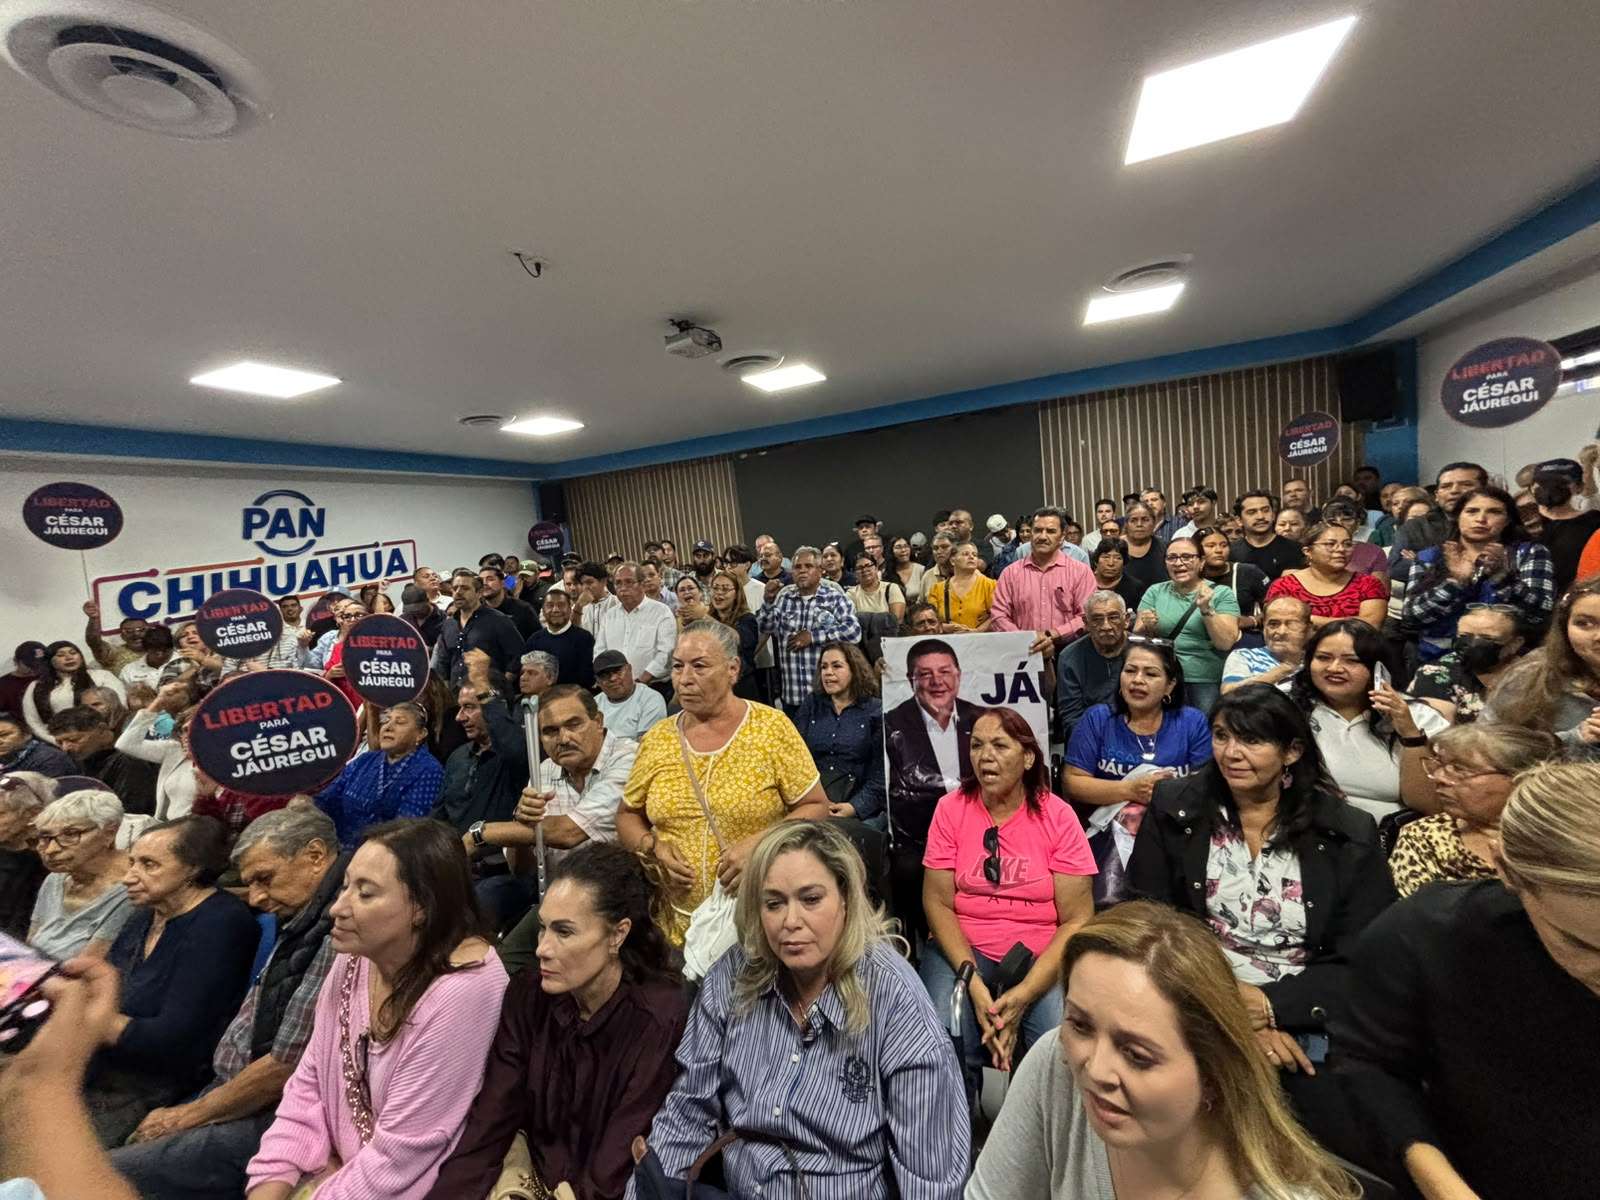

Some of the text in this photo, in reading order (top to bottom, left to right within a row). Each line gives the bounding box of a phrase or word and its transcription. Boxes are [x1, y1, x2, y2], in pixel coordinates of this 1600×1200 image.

[1451, 350, 1546, 380] LIBERTAD
[1485, 371, 1509, 380] PARA
[1462, 376, 1535, 401] CÉSAR
[1459, 390, 1540, 414] JÁUREGUI
[1289, 436, 1327, 450] CÉSAR
[45, 513, 104, 527] CÉSAR
[242, 507, 326, 541] PAN
[43, 525, 108, 536] JÁUREGUI
[215, 621, 267, 638] CÉSAR
[216, 631, 273, 648] JÁUREGUI
[349, 636, 417, 649] LIBERTAD
[360, 658, 411, 675] CÉSAR
[358, 674, 415, 688] JÁUREGUI
[203, 692, 333, 730] LIBERTAD
[259, 717, 290, 730] PARA
[230, 726, 329, 761] CÉSAR
[231, 744, 337, 778] JÁUREGUI
[971, 855, 1029, 882] NKE
